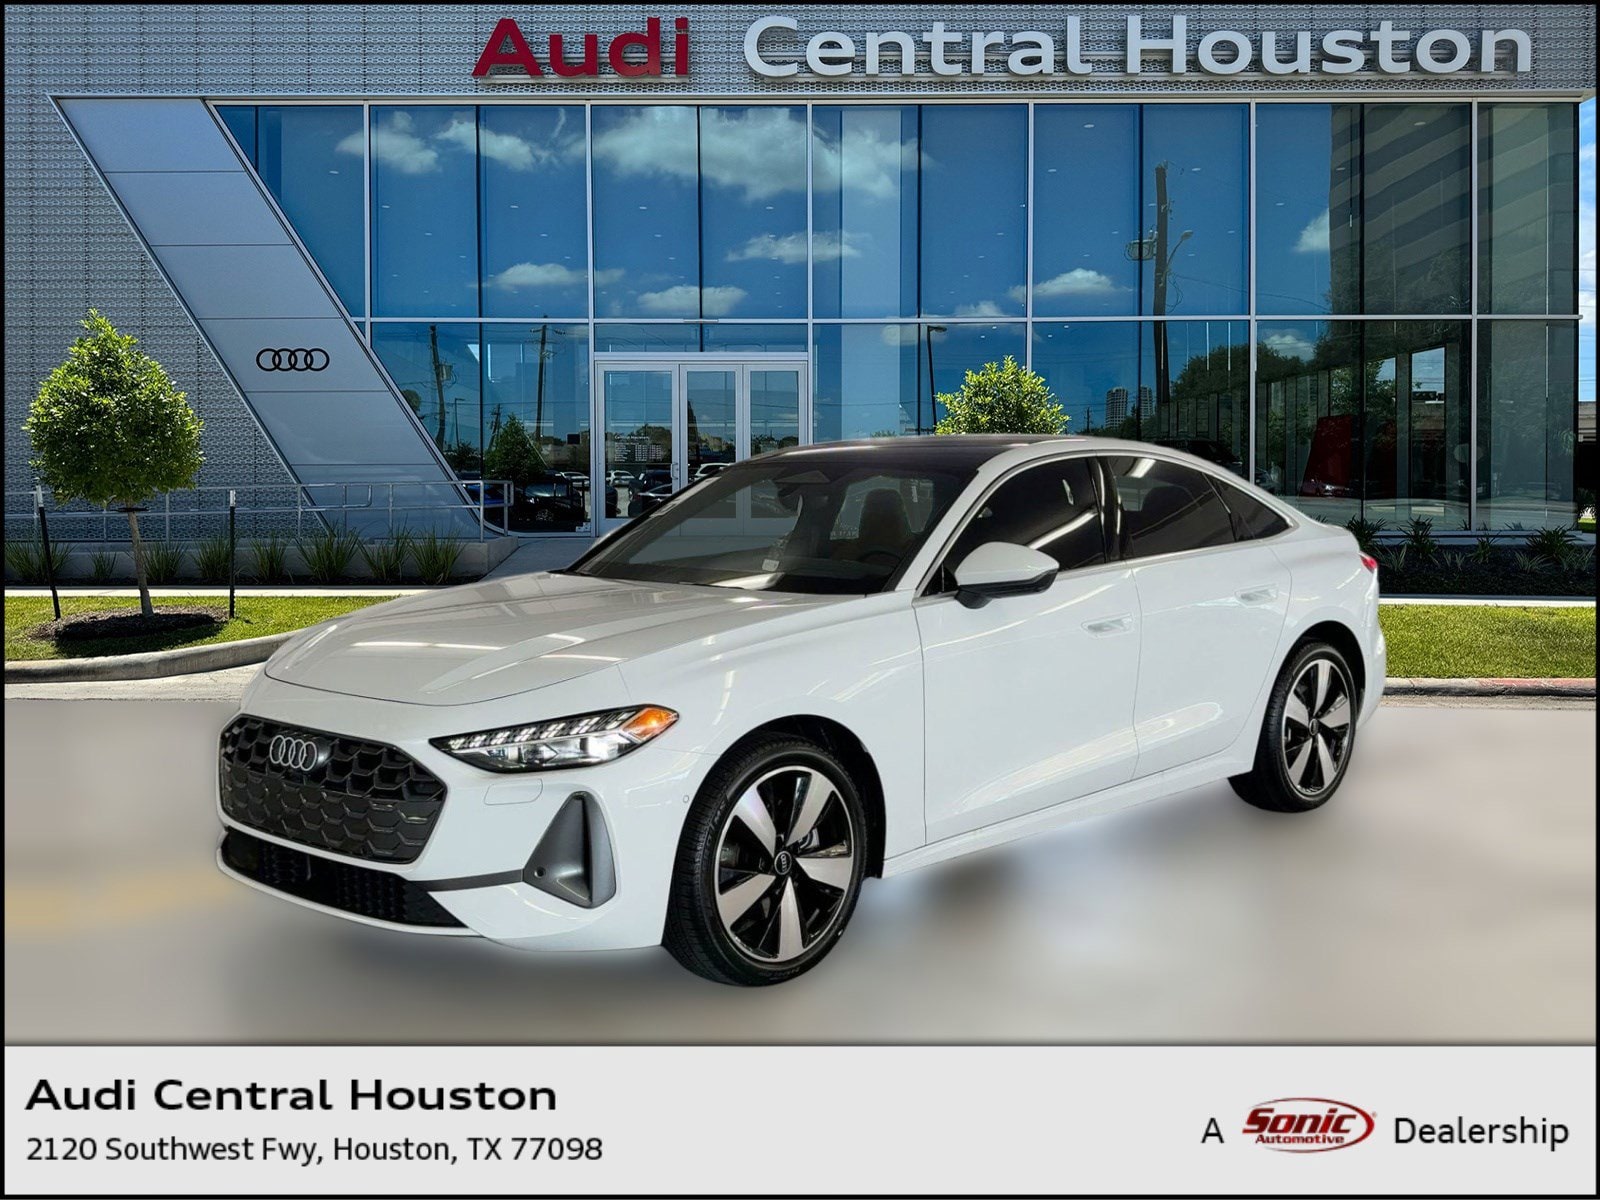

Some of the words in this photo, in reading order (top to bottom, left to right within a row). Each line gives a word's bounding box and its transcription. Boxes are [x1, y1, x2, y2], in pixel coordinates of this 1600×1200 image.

[472, 17, 690, 77] Audi
[743, 15, 1093, 77] Central
[1126, 14, 1532, 75] Houston
